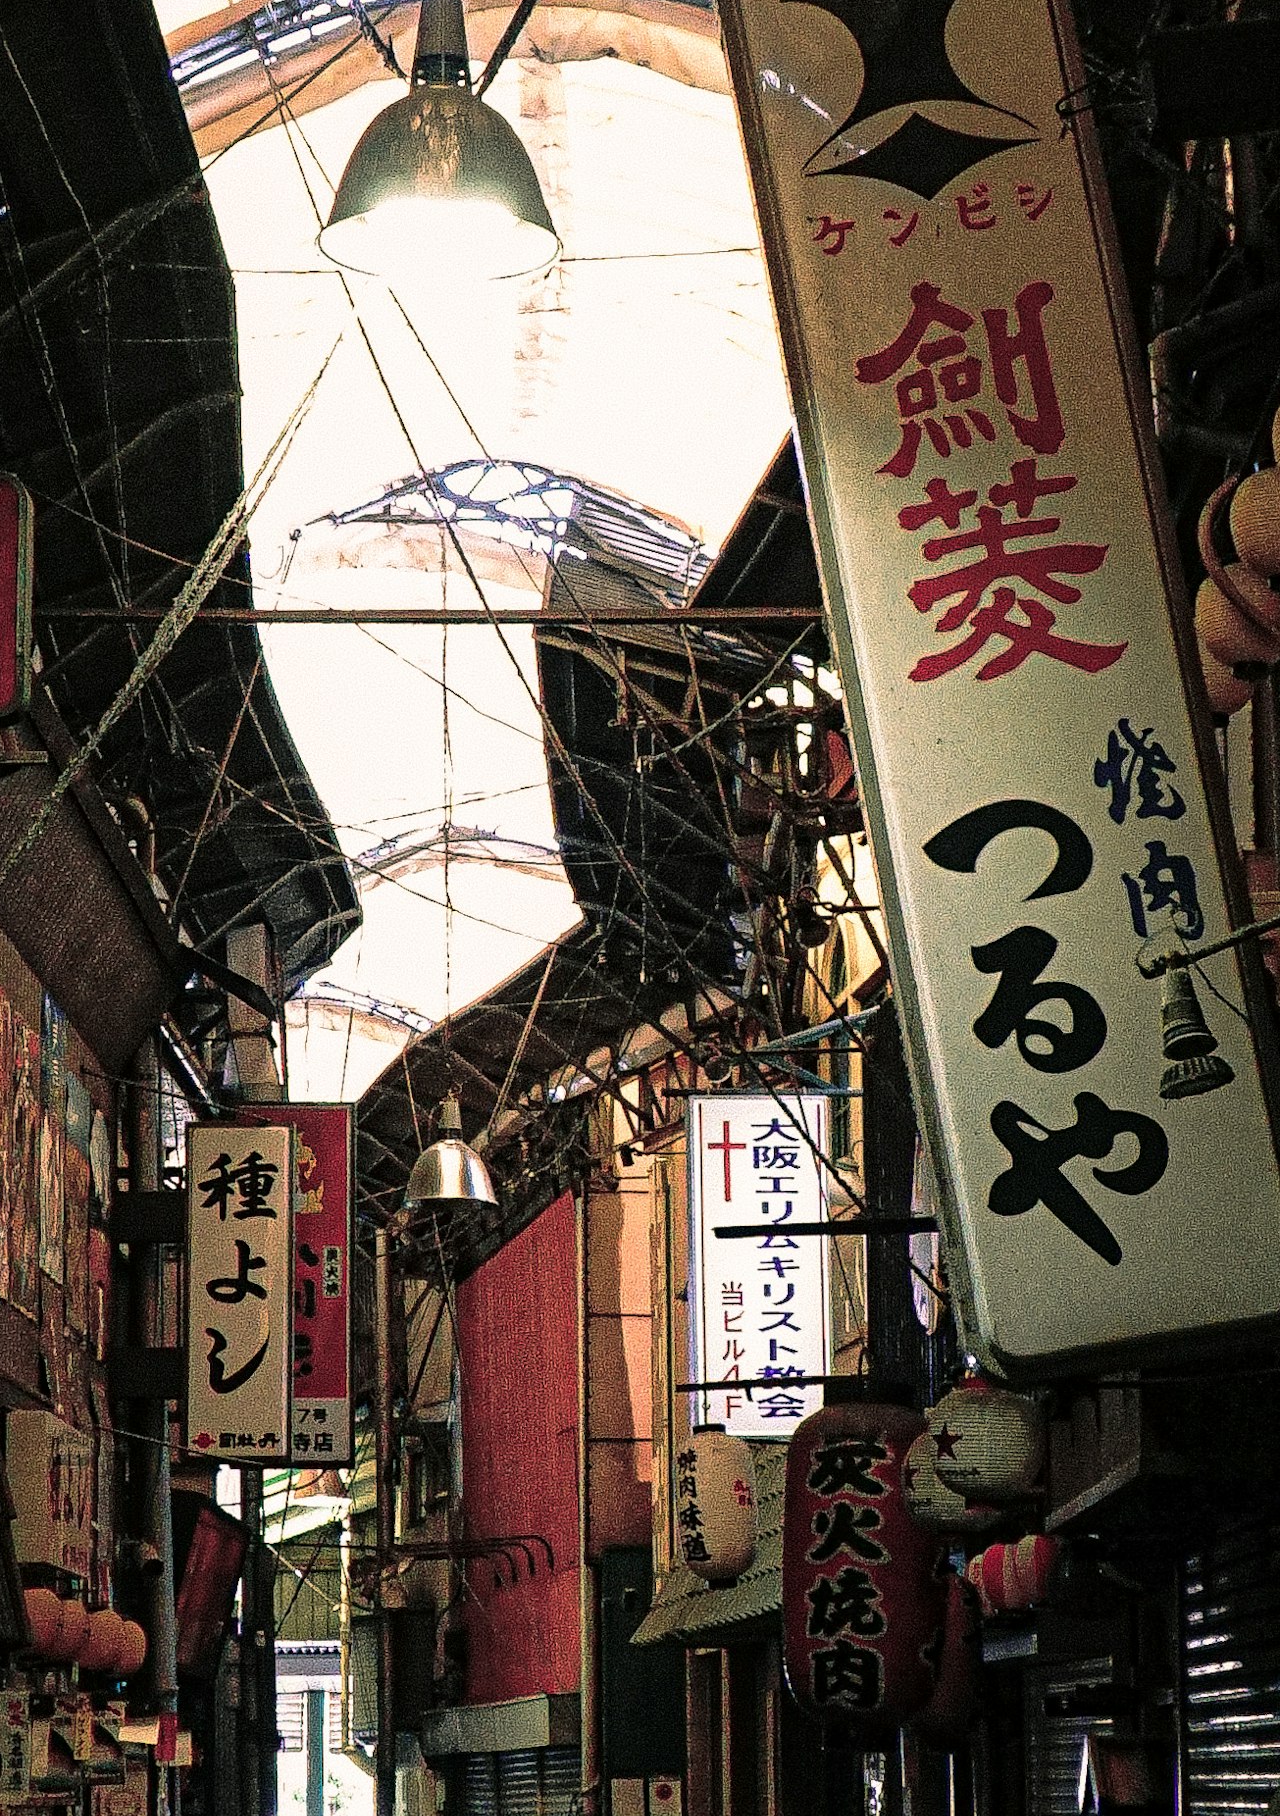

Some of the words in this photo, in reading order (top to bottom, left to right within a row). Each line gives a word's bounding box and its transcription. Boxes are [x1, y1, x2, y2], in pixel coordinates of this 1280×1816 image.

[814, 183, 1054, 256] ケンビシ
[924, 799, 1170, 1265] つるや
[196, 1151, 279, 1395] 種よし
[807, 1431, 888, 1706] 炭火焼肉
